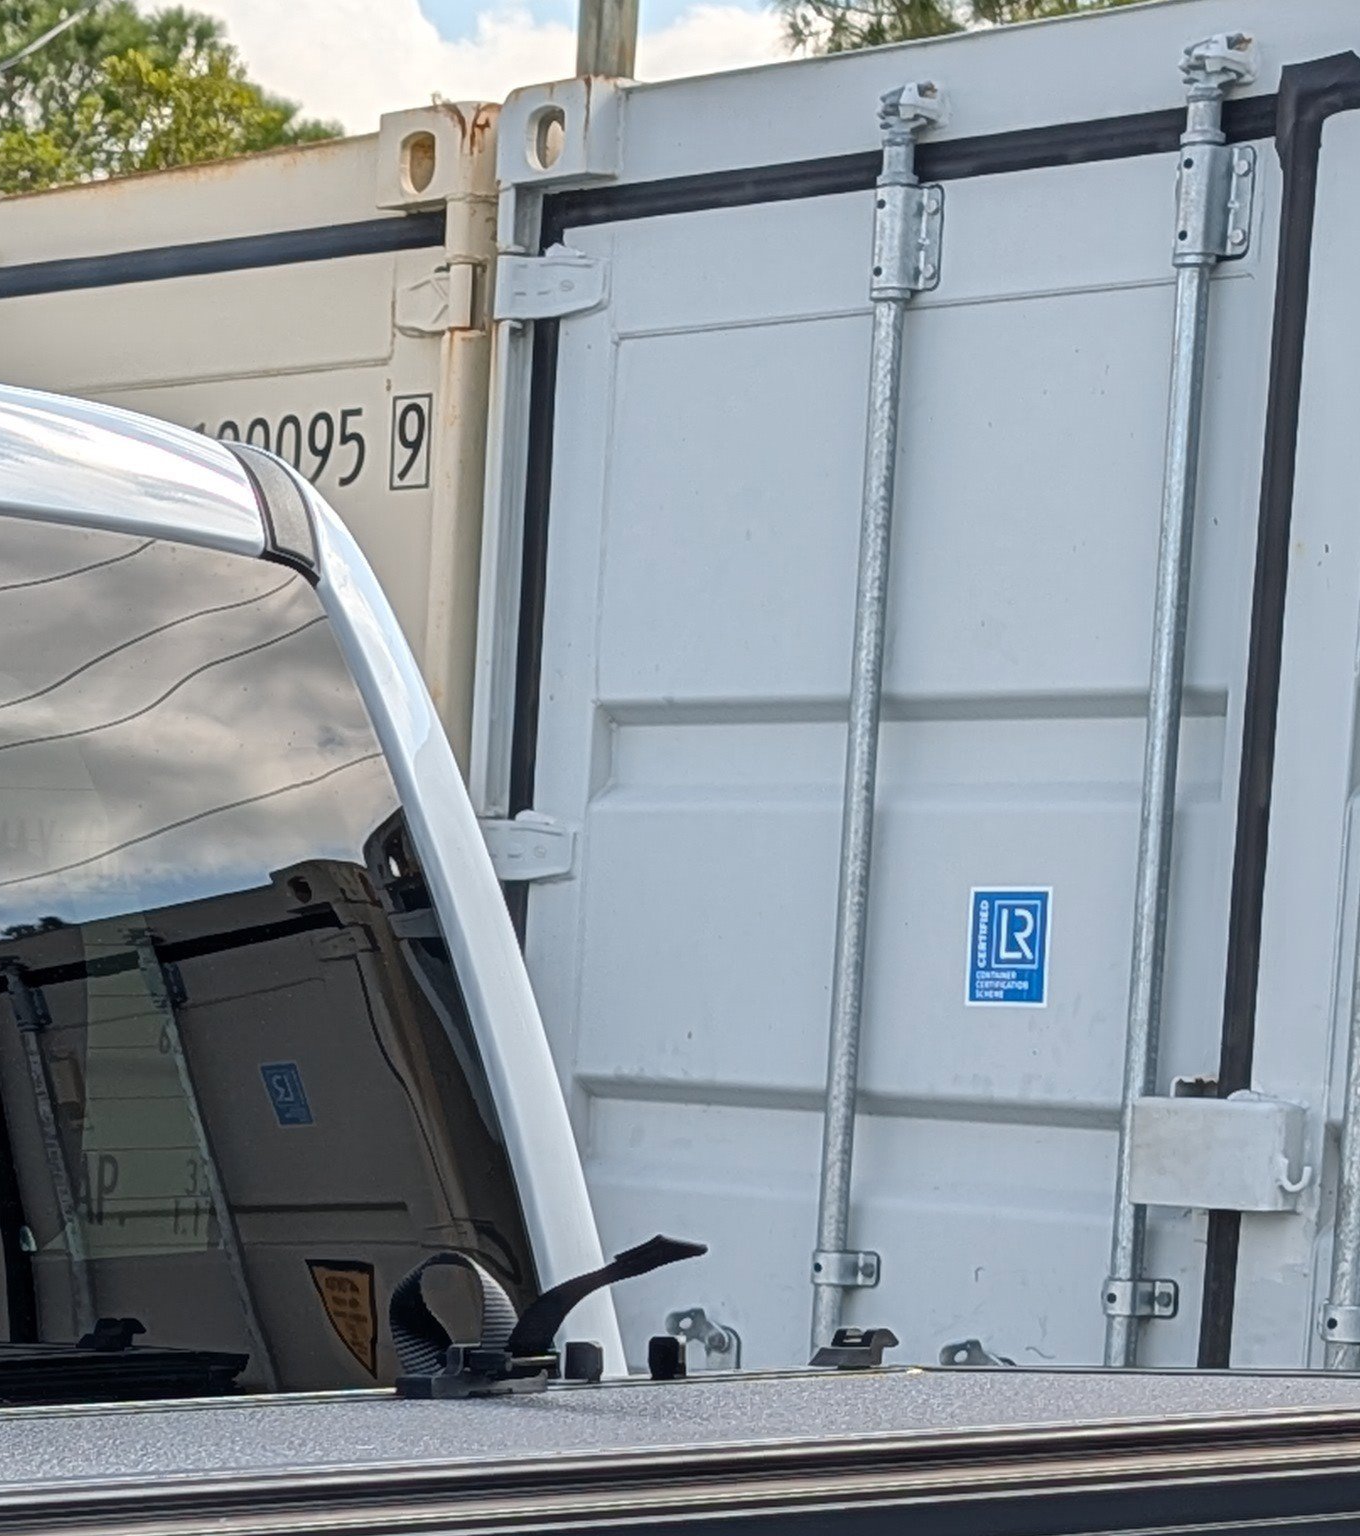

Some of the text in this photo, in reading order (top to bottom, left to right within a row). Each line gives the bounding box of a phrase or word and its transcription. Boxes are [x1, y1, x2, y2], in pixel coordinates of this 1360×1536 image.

[193, 401, 427, 488] 095 9
[977, 900, 989, 968] CERTIFIED
[1000, 908, 1034, 959] LR
